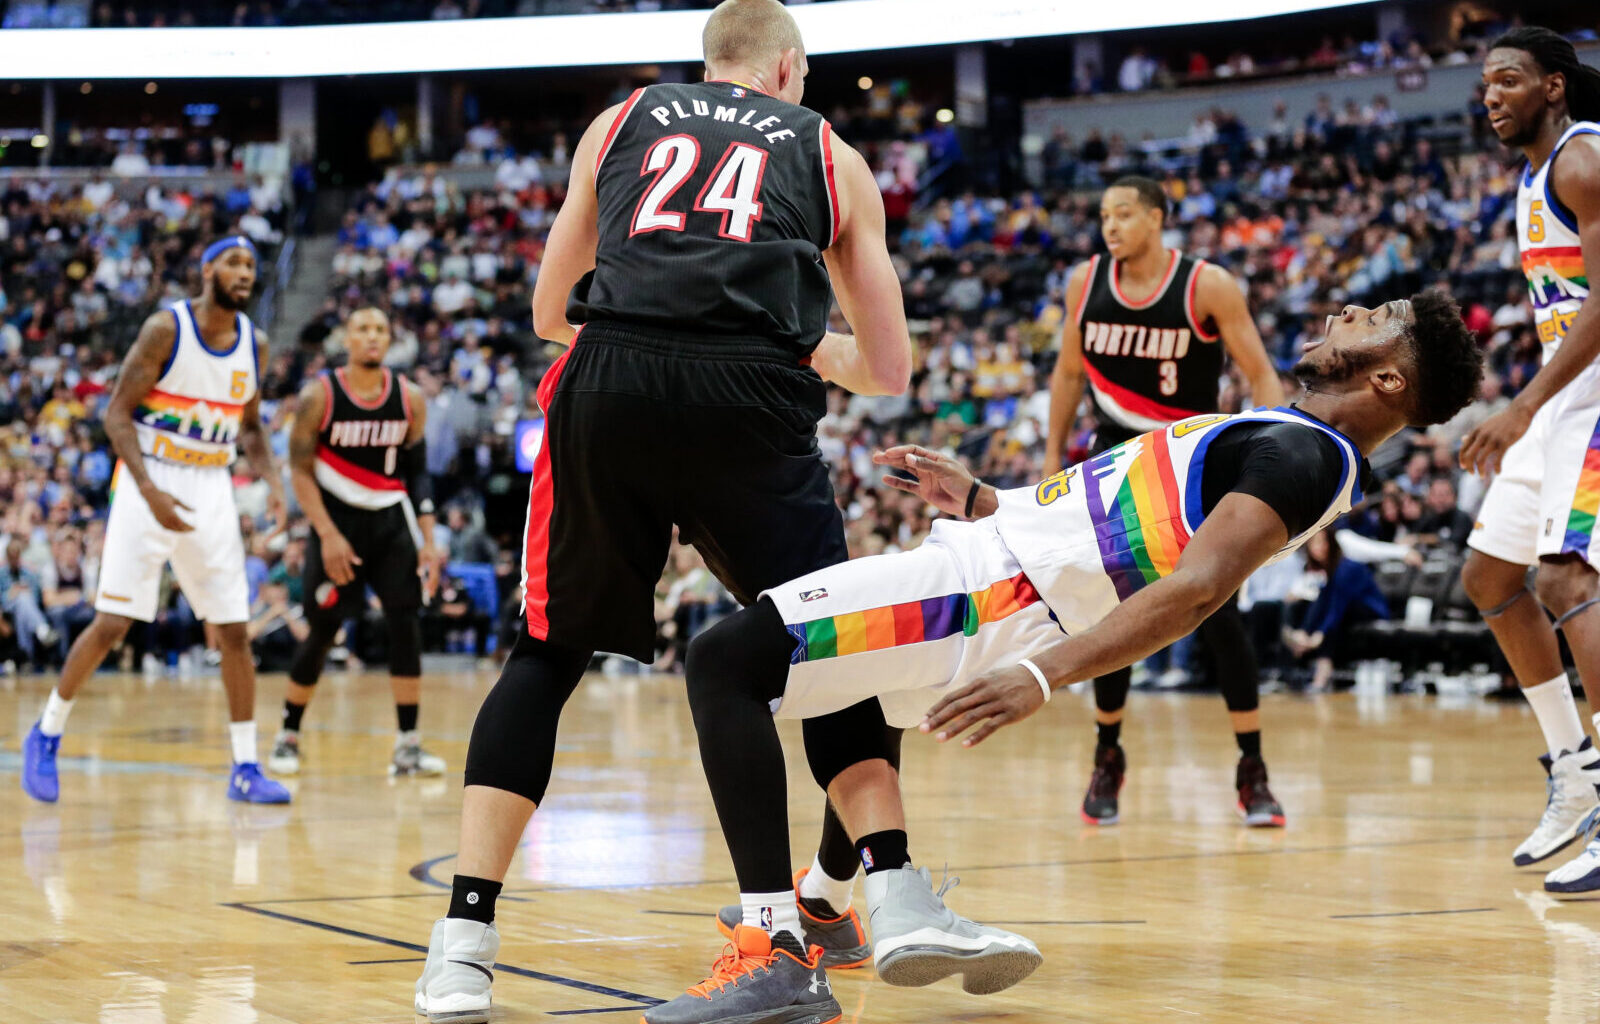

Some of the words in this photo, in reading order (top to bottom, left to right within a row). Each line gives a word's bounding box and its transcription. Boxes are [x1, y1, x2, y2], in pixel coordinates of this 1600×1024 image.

[650, 99, 796, 144] PLUMLEE
[629, 133, 769, 243] 24
[1084, 321, 1191, 359] PORTLAND
[230, 370, 248, 400] 5
[1159, 360, 1178, 396] 3
[330, 421, 408, 447] PORTLAND
